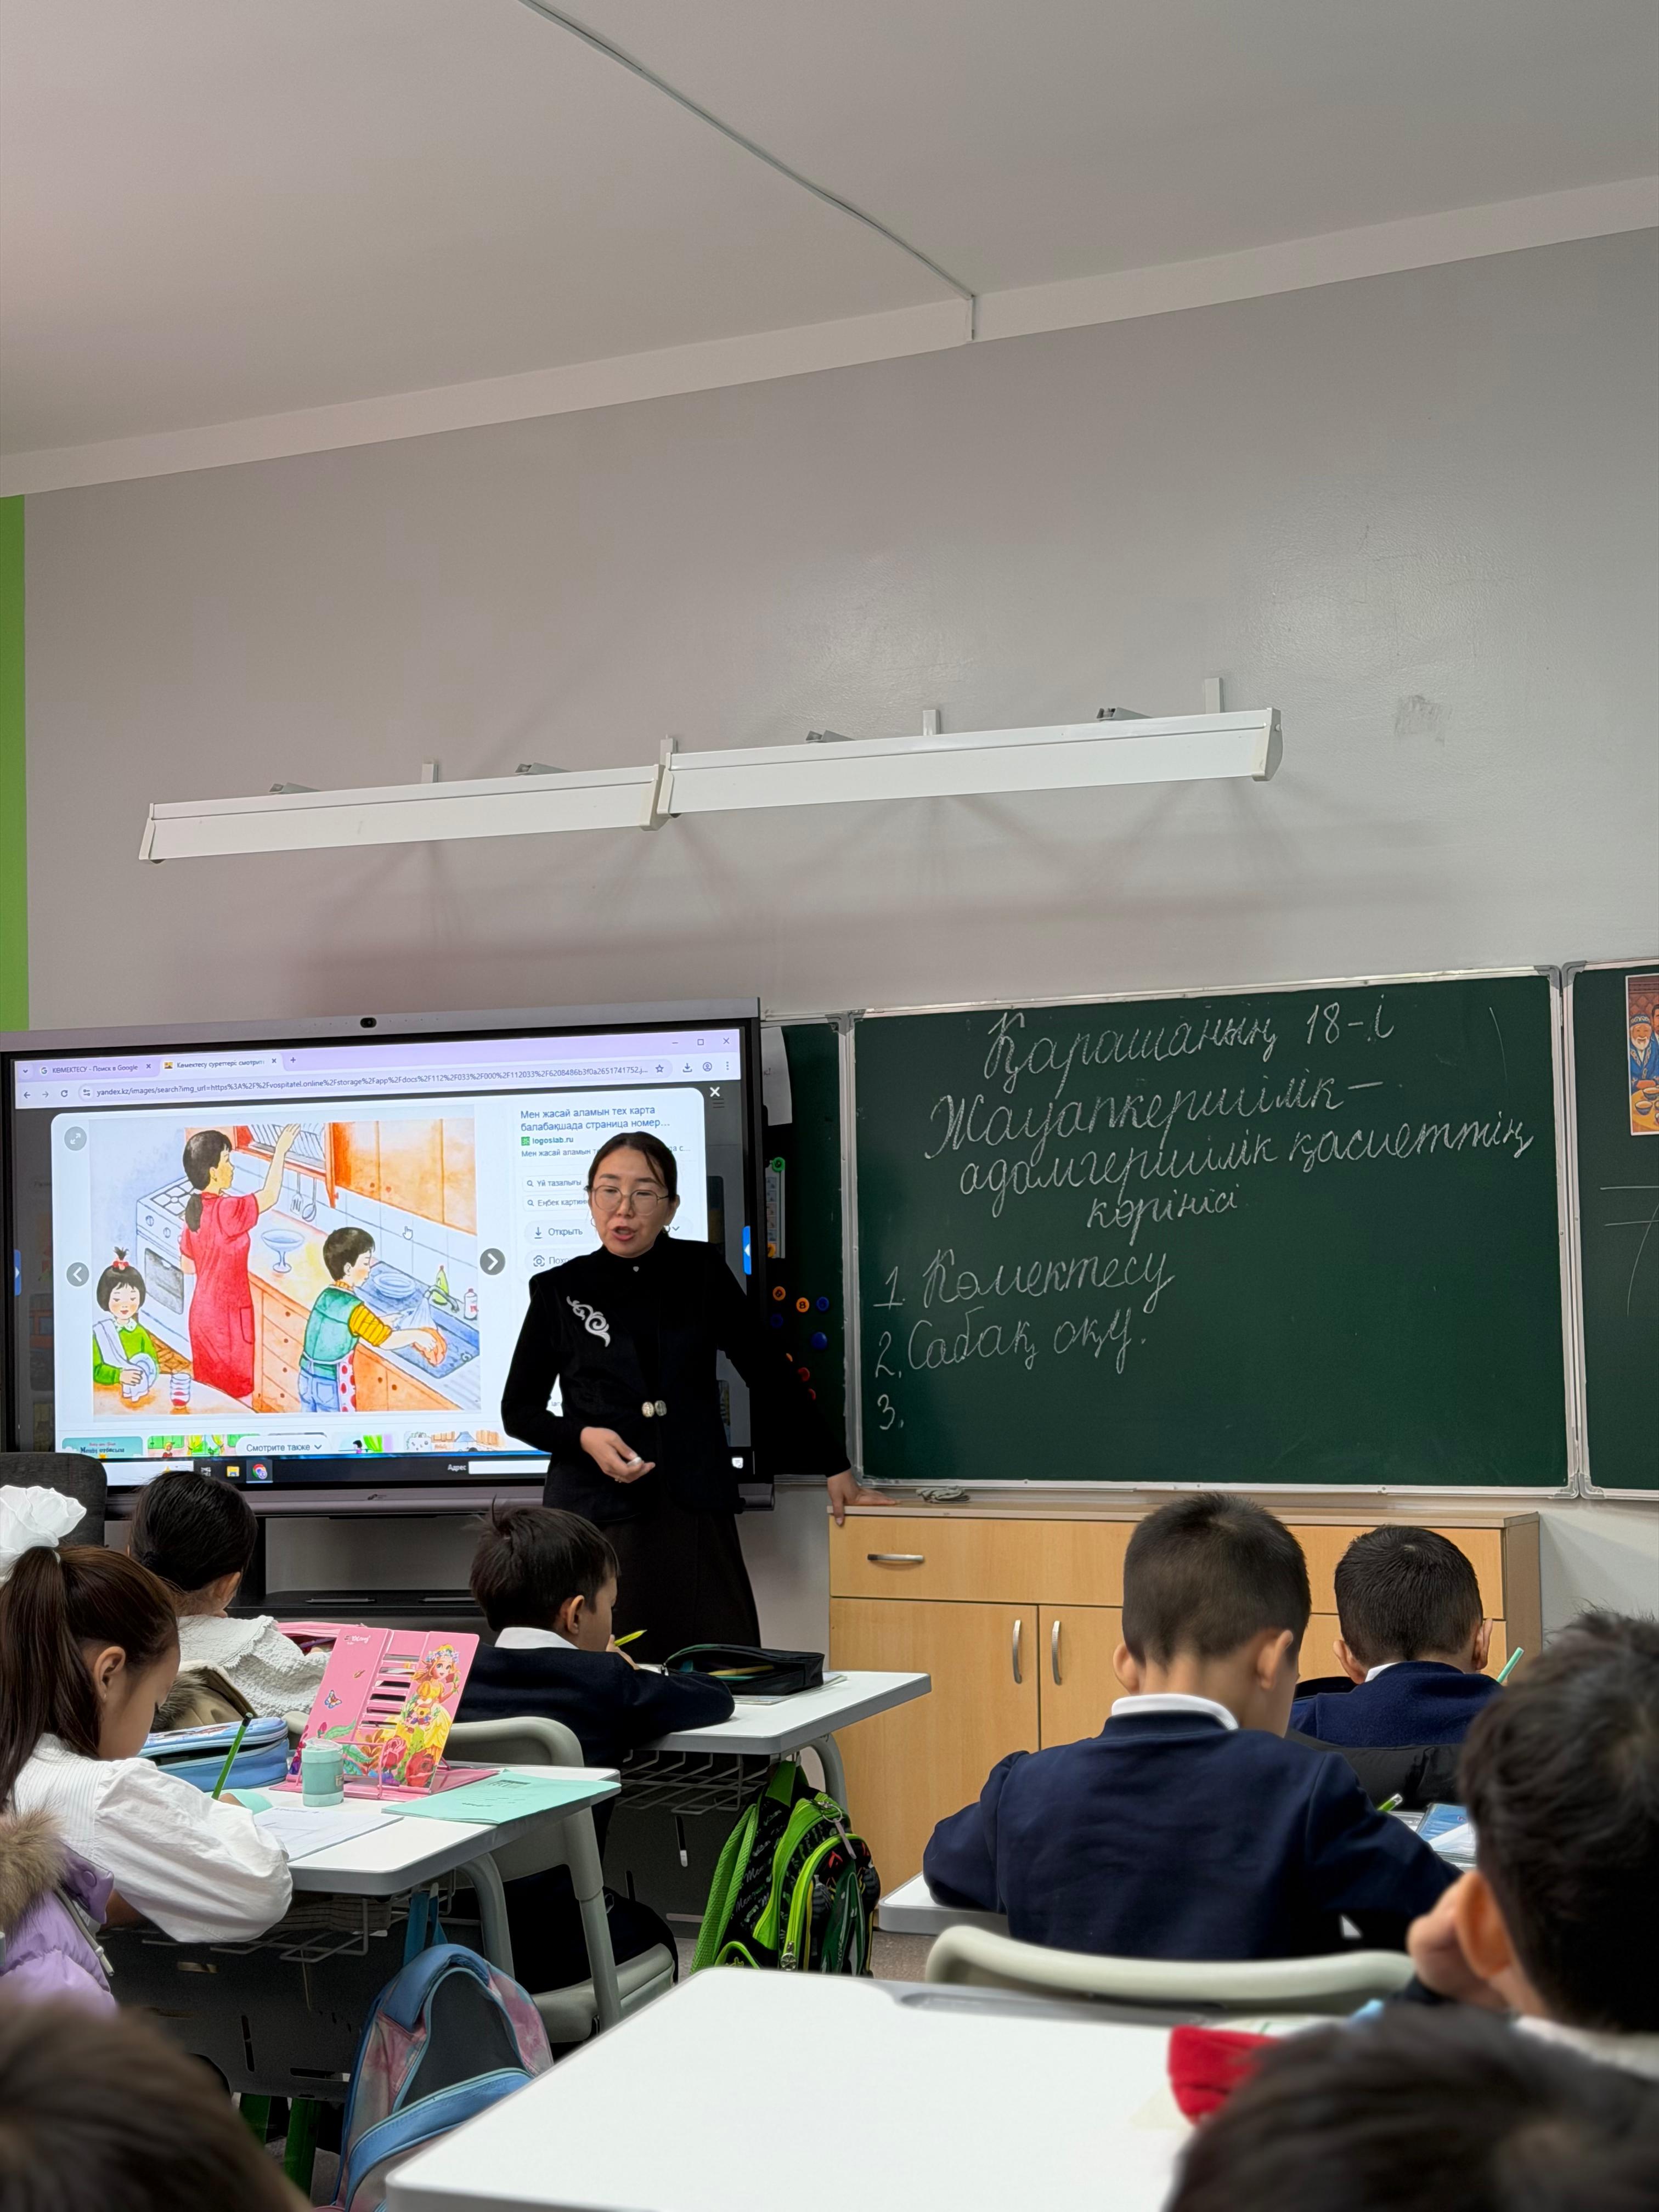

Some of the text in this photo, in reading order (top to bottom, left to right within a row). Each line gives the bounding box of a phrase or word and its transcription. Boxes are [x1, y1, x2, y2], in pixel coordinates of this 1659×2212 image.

[984, 1012, 1278, 1099] Қарашаның
[521, 1106, 655, 1119] Мен жасай аламын тех карта
[521, 1122, 583, 1132] балабақшада
[585, 1120, 629, 1131] страница
[925, 1069, 1344, 1167] Жауапкершілік
[532, 1136, 574, 1146] logoslab.ru
[961, 1110, 1534, 1218] адамгершілік қасиеттің
[548, 1227, 583, 1237] Открыть
[1087, 1183, 1239, 1246] көрінісі
[922, 1249, 1175, 1313] Көмектесу
[875, 1331, 902, 1378] 2.
[908, 1306, 1039, 1370] Сабақ
[877, 1394, 905, 1430] 3.
[246, 1443, 285, 1453] Смотрите
